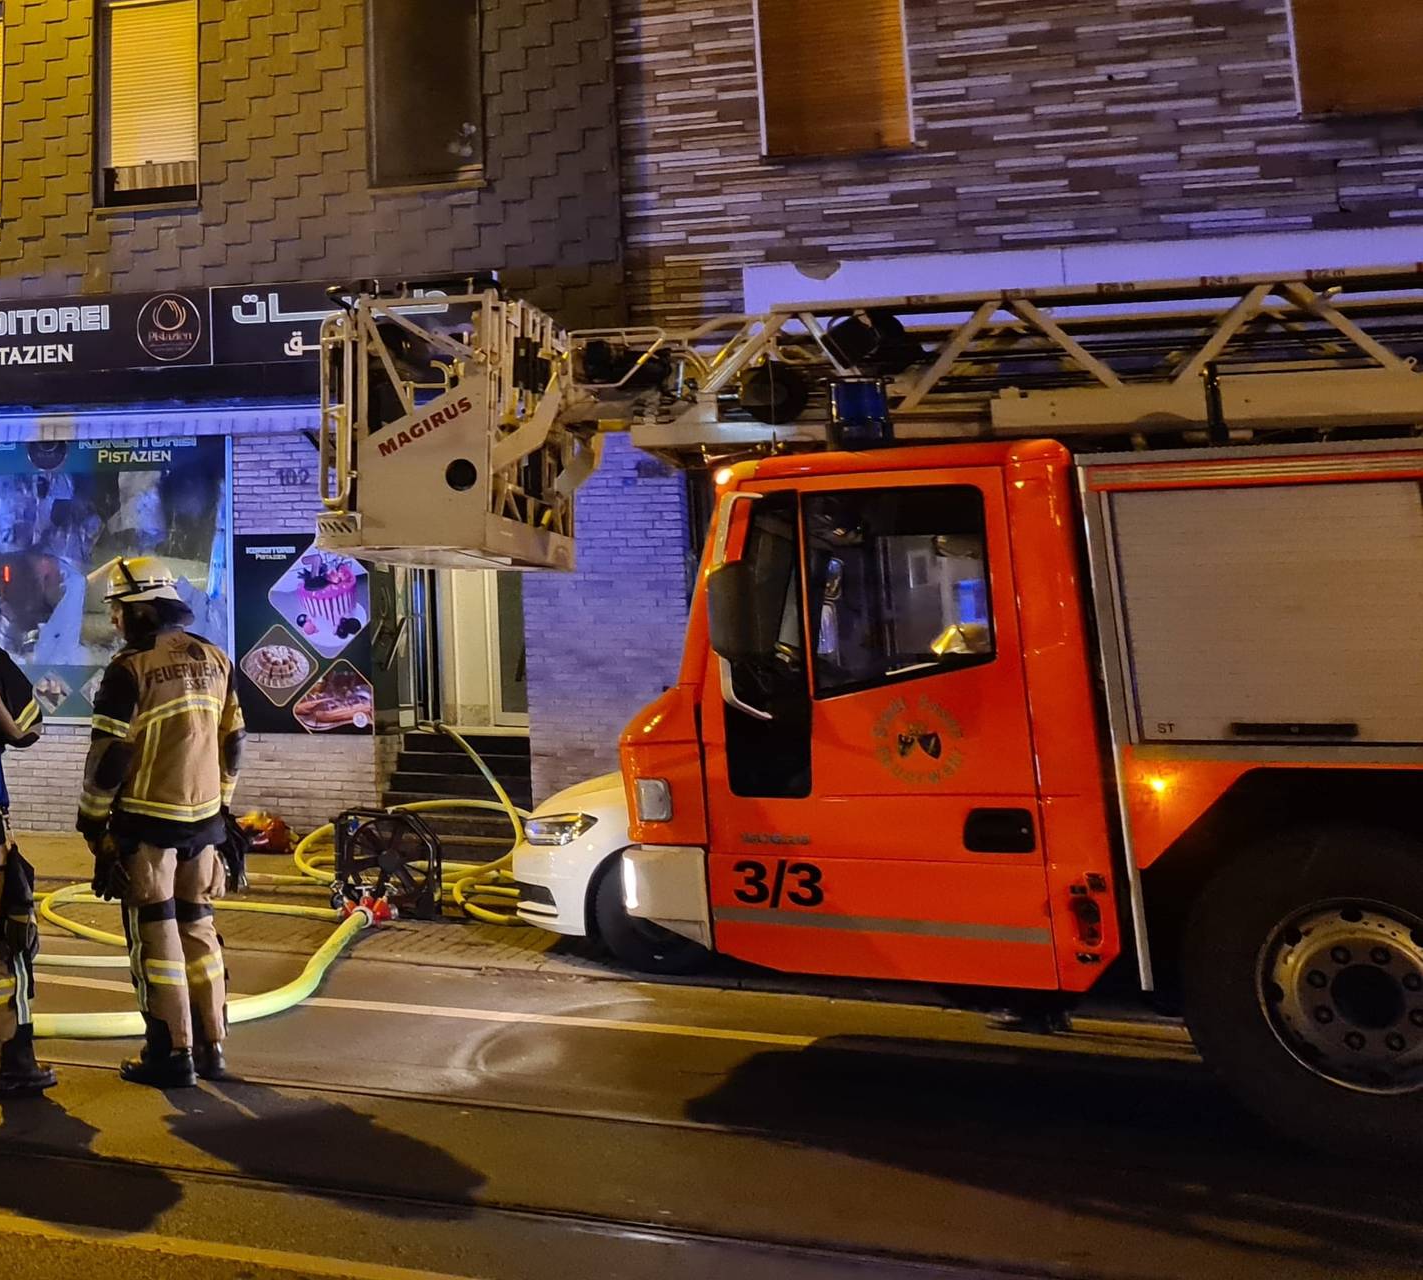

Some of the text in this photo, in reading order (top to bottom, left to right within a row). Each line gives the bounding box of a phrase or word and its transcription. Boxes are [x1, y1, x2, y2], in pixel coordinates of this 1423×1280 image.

[378, 397, 472, 457] MAGIRUS
[97, 449, 172, 463] PISTAZIEN
[277, 468, 309, 486] 102
[1157, 722, 1176, 734] ST
[732, 859, 825, 909] 3/3
